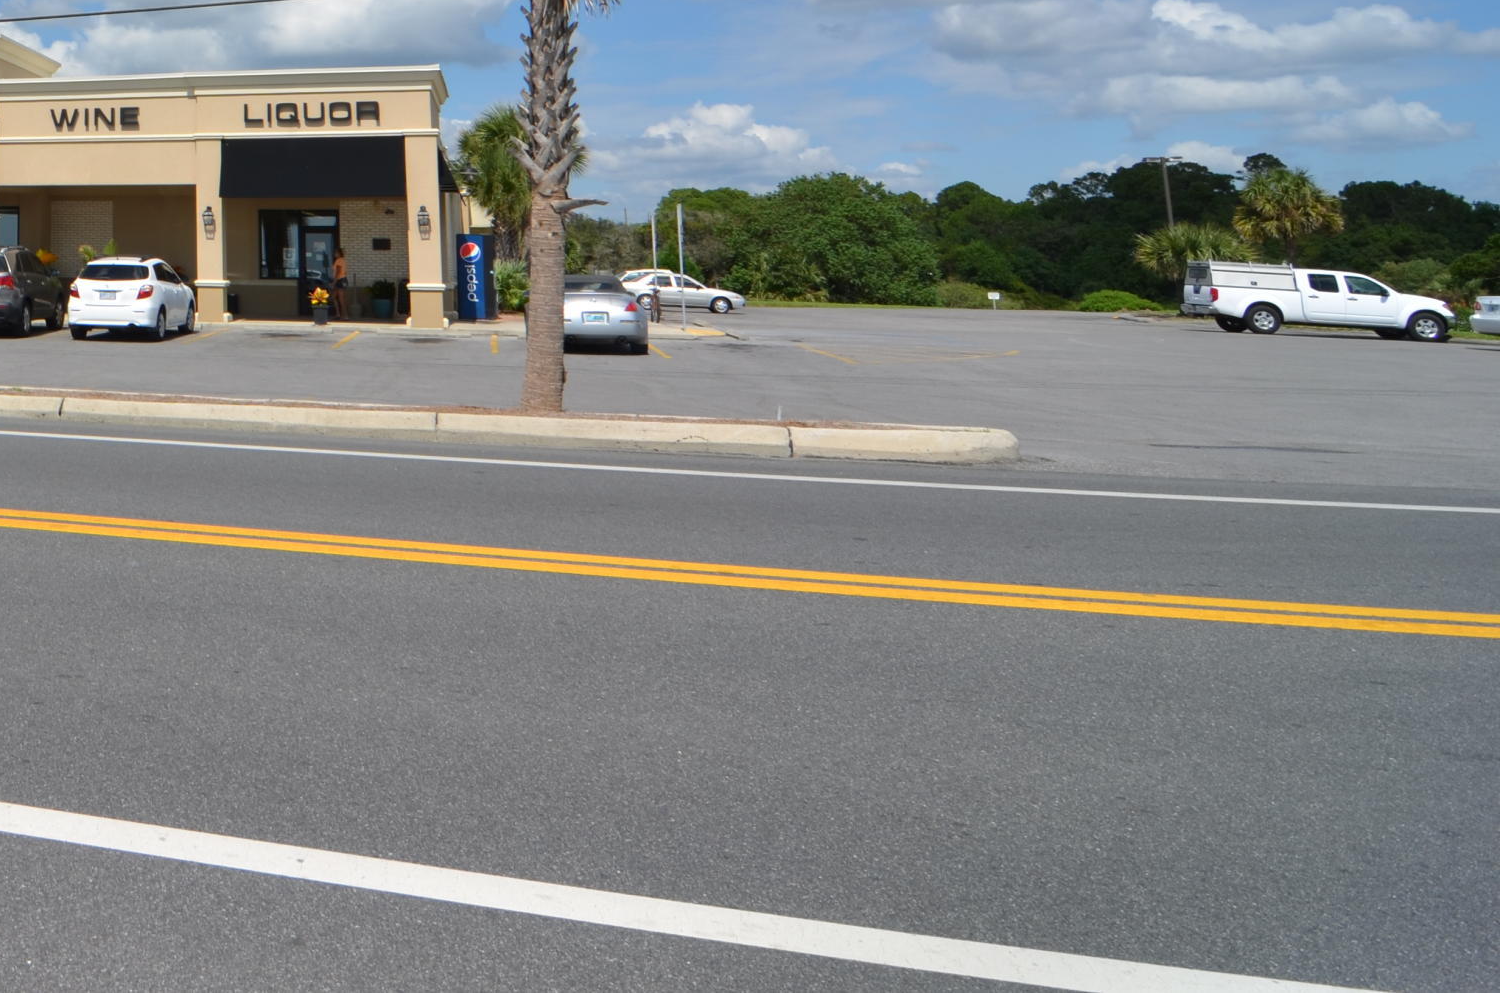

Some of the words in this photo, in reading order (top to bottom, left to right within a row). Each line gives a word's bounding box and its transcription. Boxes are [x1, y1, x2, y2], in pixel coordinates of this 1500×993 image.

[50, 107, 139, 127] WINE
[244, 101, 380, 124] LIQUOR
[464, 264, 479, 302] pepsi
